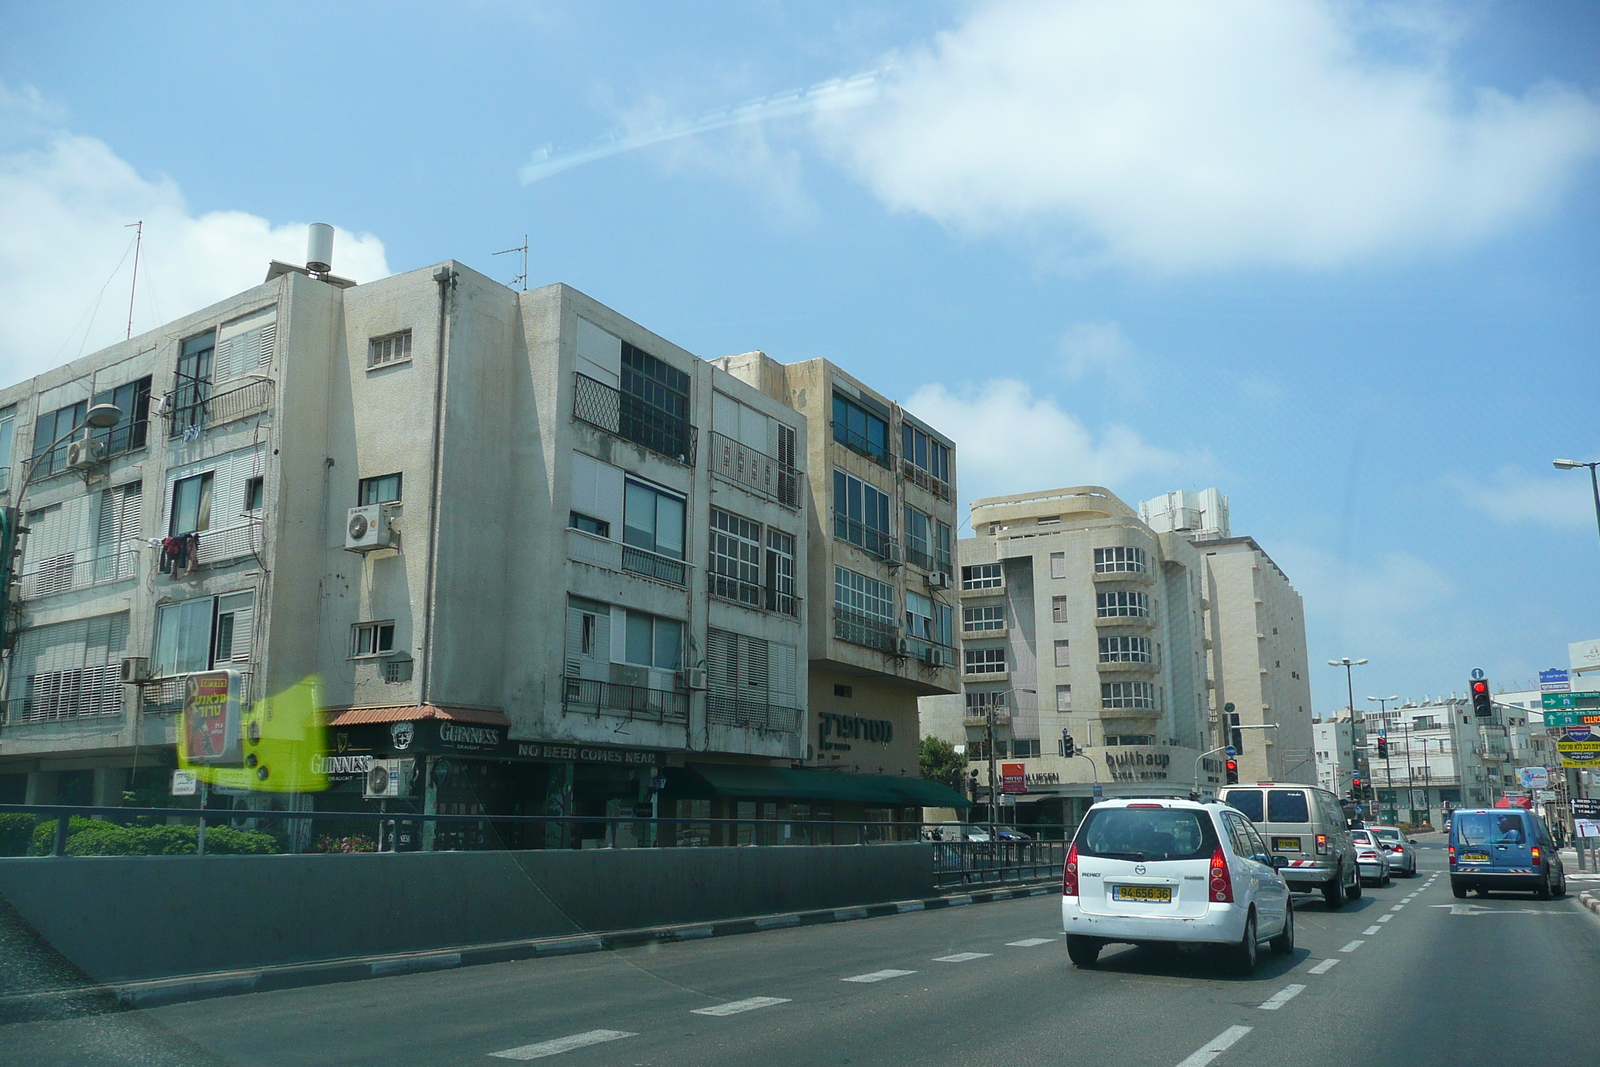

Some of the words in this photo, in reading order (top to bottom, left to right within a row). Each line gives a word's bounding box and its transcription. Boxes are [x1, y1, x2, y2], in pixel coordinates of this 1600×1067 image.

[439, 721, 500, 745] GUINNESS
[310, 753, 373, 774] GUINNESS
[518, 743, 540, 757] NO
[543, 745, 577, 760] BEER
[580, 748, 623, 762] COMES
[625, 751, 656, 764] NEAR
[1106, 751, 1170, 769] bulthaup
